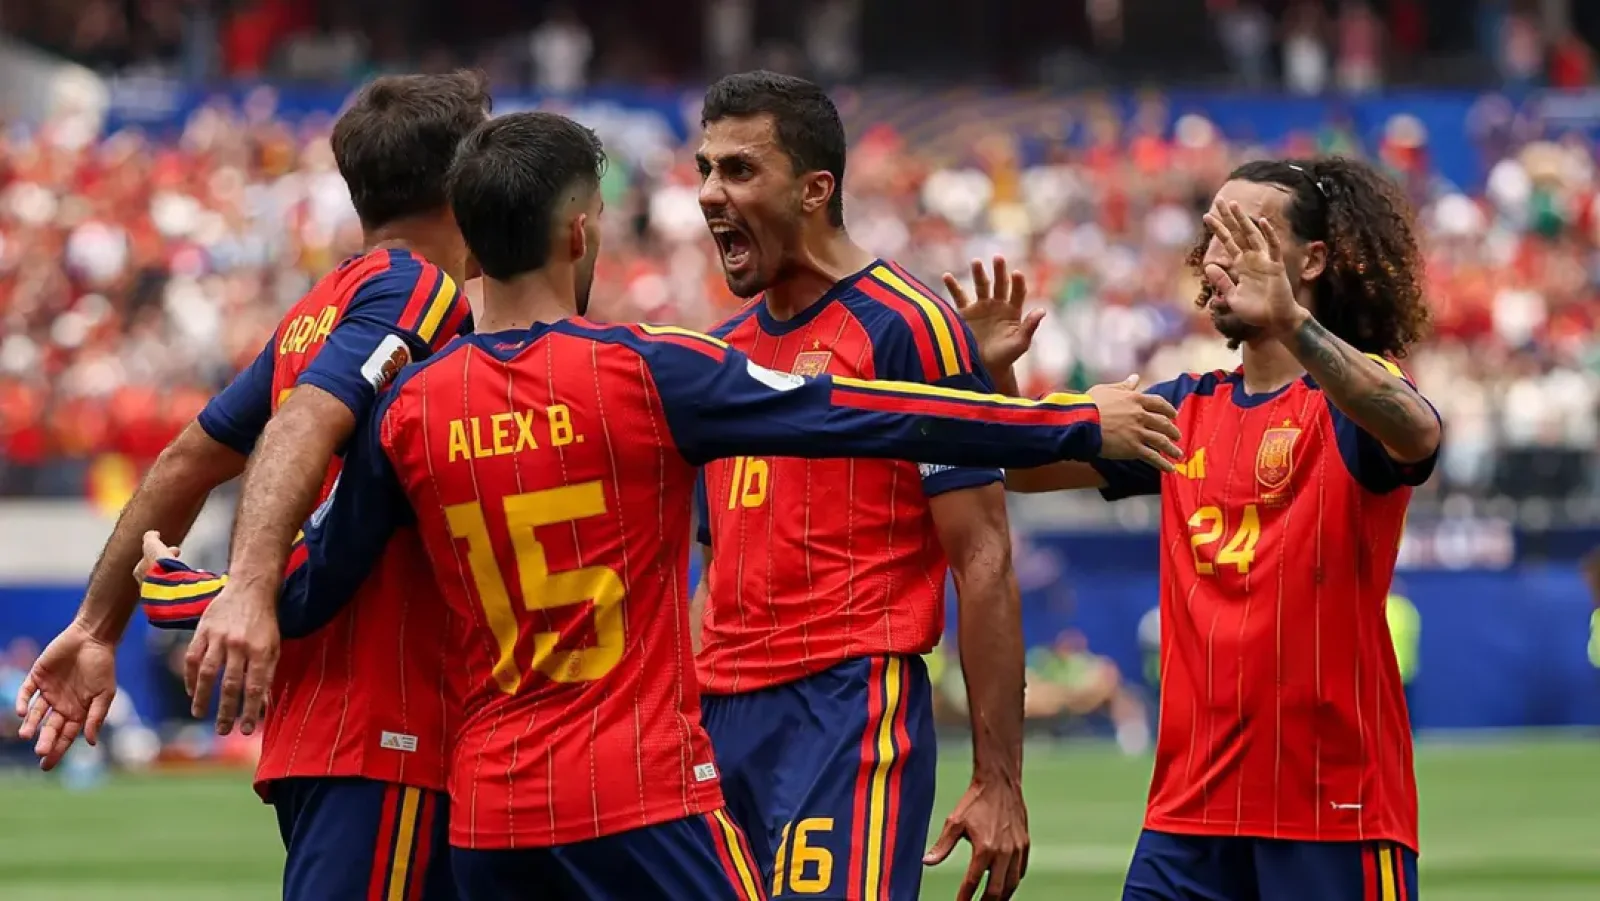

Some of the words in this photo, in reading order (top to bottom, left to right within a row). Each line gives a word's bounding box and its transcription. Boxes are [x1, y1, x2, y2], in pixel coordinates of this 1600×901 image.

[449, 409, 539, 462] ALEX
[547, 404, 585, 447] B.
[728, 456, 768, 510] 16
[1187, 504, 1260, 575] 24
[445, 480, 625, 695] 15
[772, 817, 834, 897] 16
